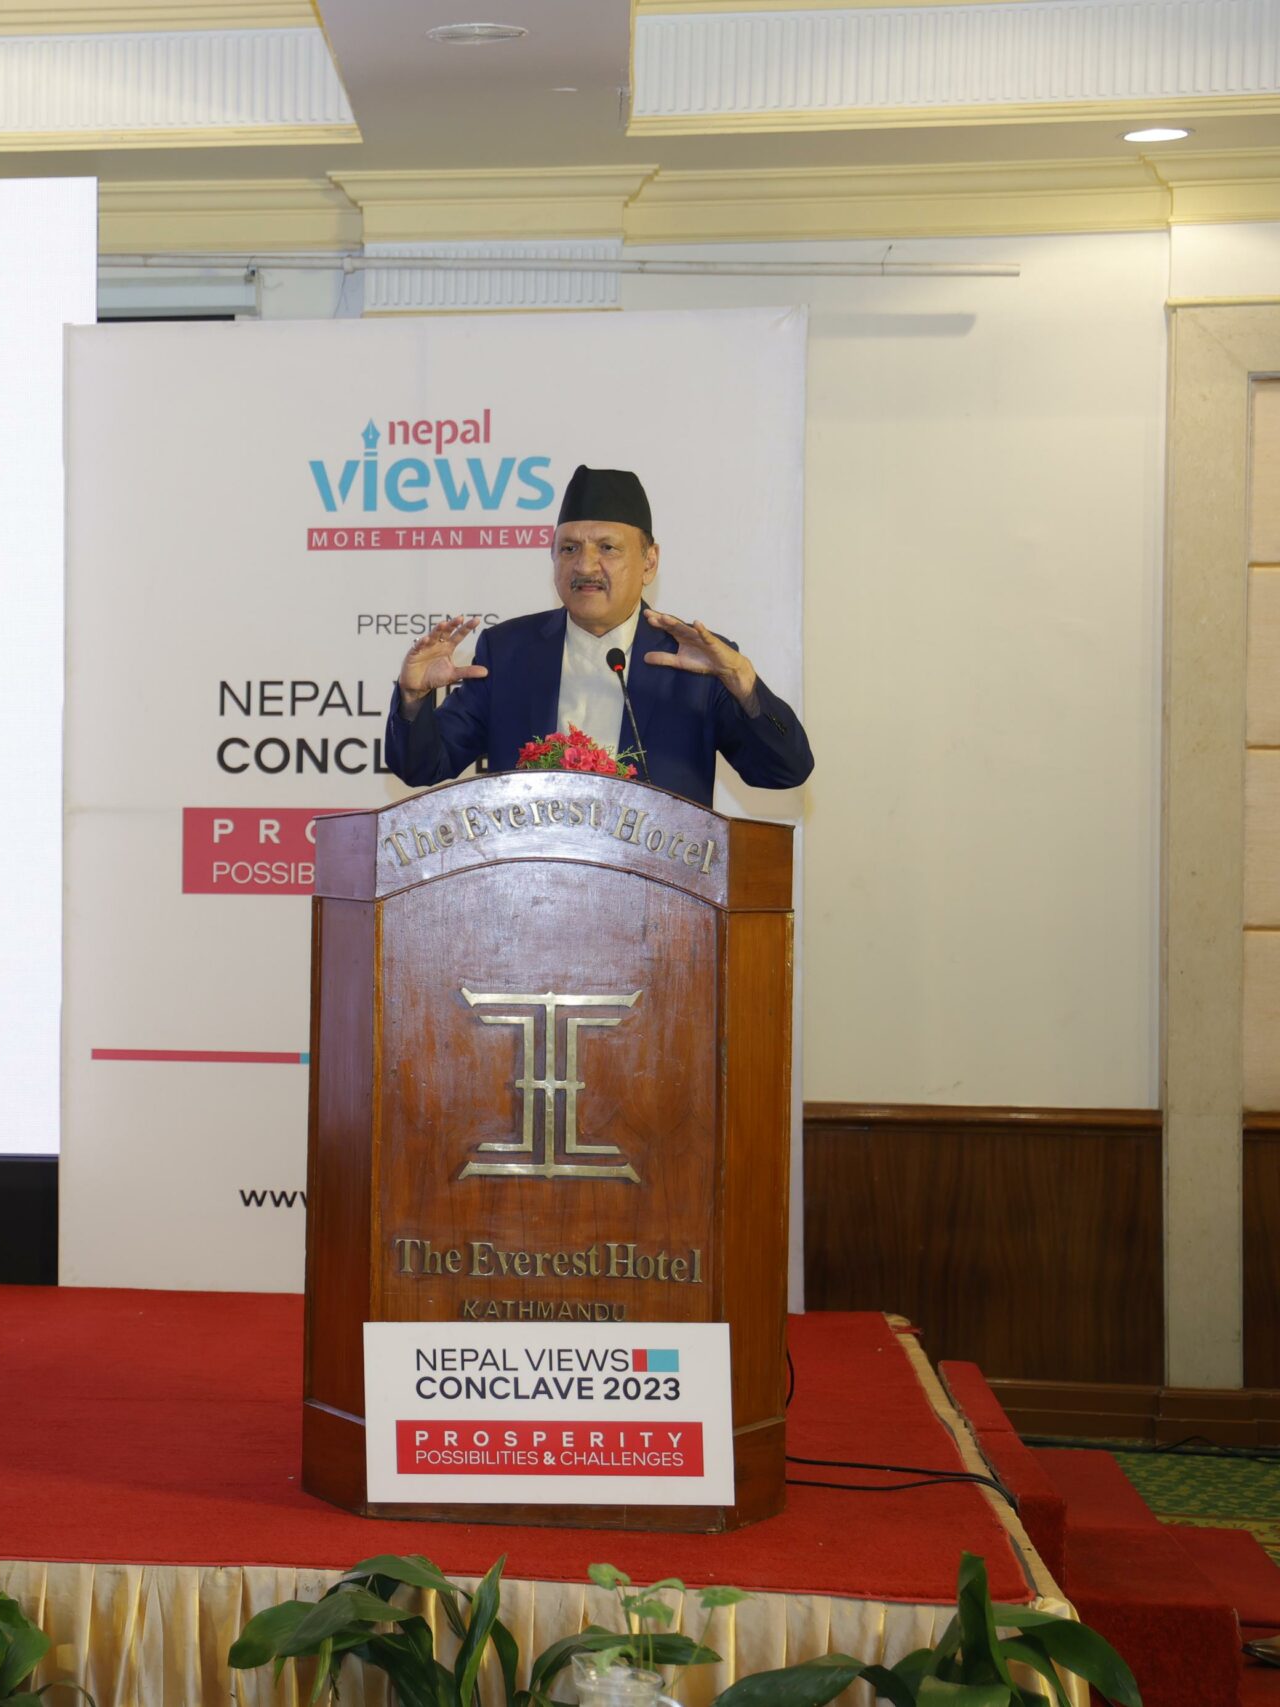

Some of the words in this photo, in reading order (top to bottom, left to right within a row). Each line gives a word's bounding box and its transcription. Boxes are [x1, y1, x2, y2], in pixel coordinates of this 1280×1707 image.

[389, 409, 491, 455] nepal
[308, 418, 555, 513] views
[312, 530, 381, 547] MORE
[396, 529, 463, 546] THAN
[479, 528, 550, 546] NEWS
[219, 680, 382, 717] NEPAL
[382, 823, 455, 868] The
[458, 799, 602, 842] Everest
[612, 805, 718, 875] Hotel
[395, 1238, 462, 1274] The
[468, 1241, 602, 1277] Everest
[606, 1242, 704, 1284] Hotel
[463, 1299, 627, 1322] KATHMANDU
[415, 1348, 519, 1372] NEPAL
[524, 1348, 630, 1373] VIEWS
[415, 1376, 595, 1400] CONCLAVE
[603, 1377, 681, 1401] 2023
[415, 1430, 683, 1448] PROSPERITY
[415, 1450, 538, 1466] POSSIBILITIES
[542, 1451, 556, 1466] &
[560, 1451, 684, 1467] CHALLENGES
